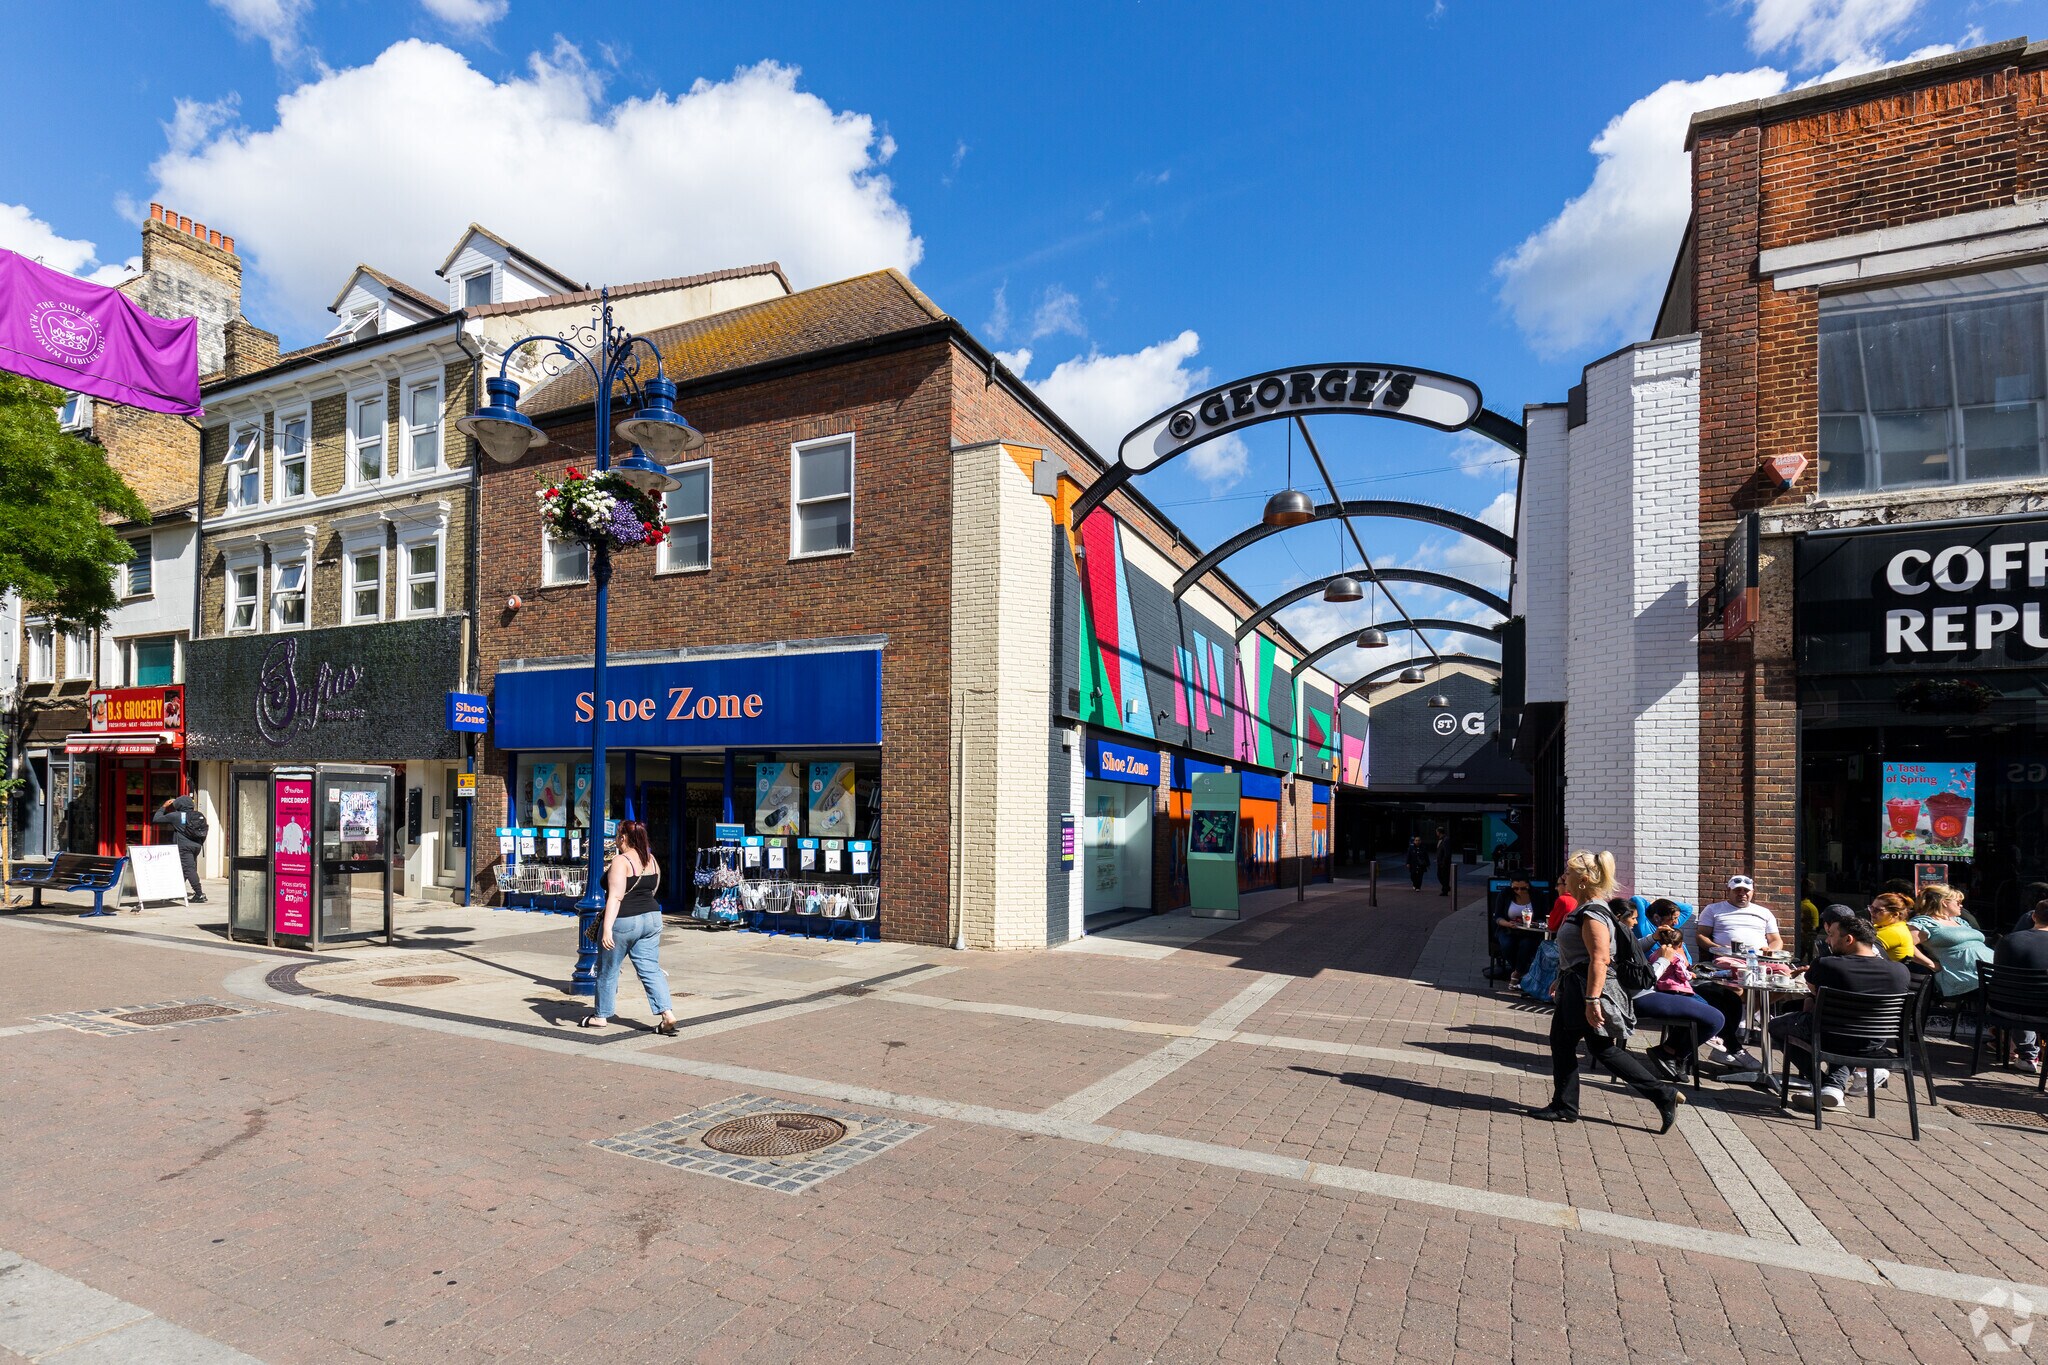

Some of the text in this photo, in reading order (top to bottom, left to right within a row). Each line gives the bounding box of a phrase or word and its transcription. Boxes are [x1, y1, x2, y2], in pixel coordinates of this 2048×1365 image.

[37, 301, 101, 328] THE QUEEN'S
[29, 313, 106, 365] PLATINUM JUBILEE 2022
[1172, 369, 1416, 431] ST GEORGE'S
[107, 699, 163, 720] B.S GROCERY
[455, 701, 485, 713] Shoe
[666, 686, 763, 721] Zone
[455, 713, 486, 724] Zone
[1437, 712, 1485, 735] ST G
[1102, 751, 1149, 776] Shoe Zone
[1886, 764, 1926, 773] A Taste
[1886, 774, 1938, 786] of Spring
[347, 800, 372, 811] CIRCUS
[292, 881, 307, 889] starting
